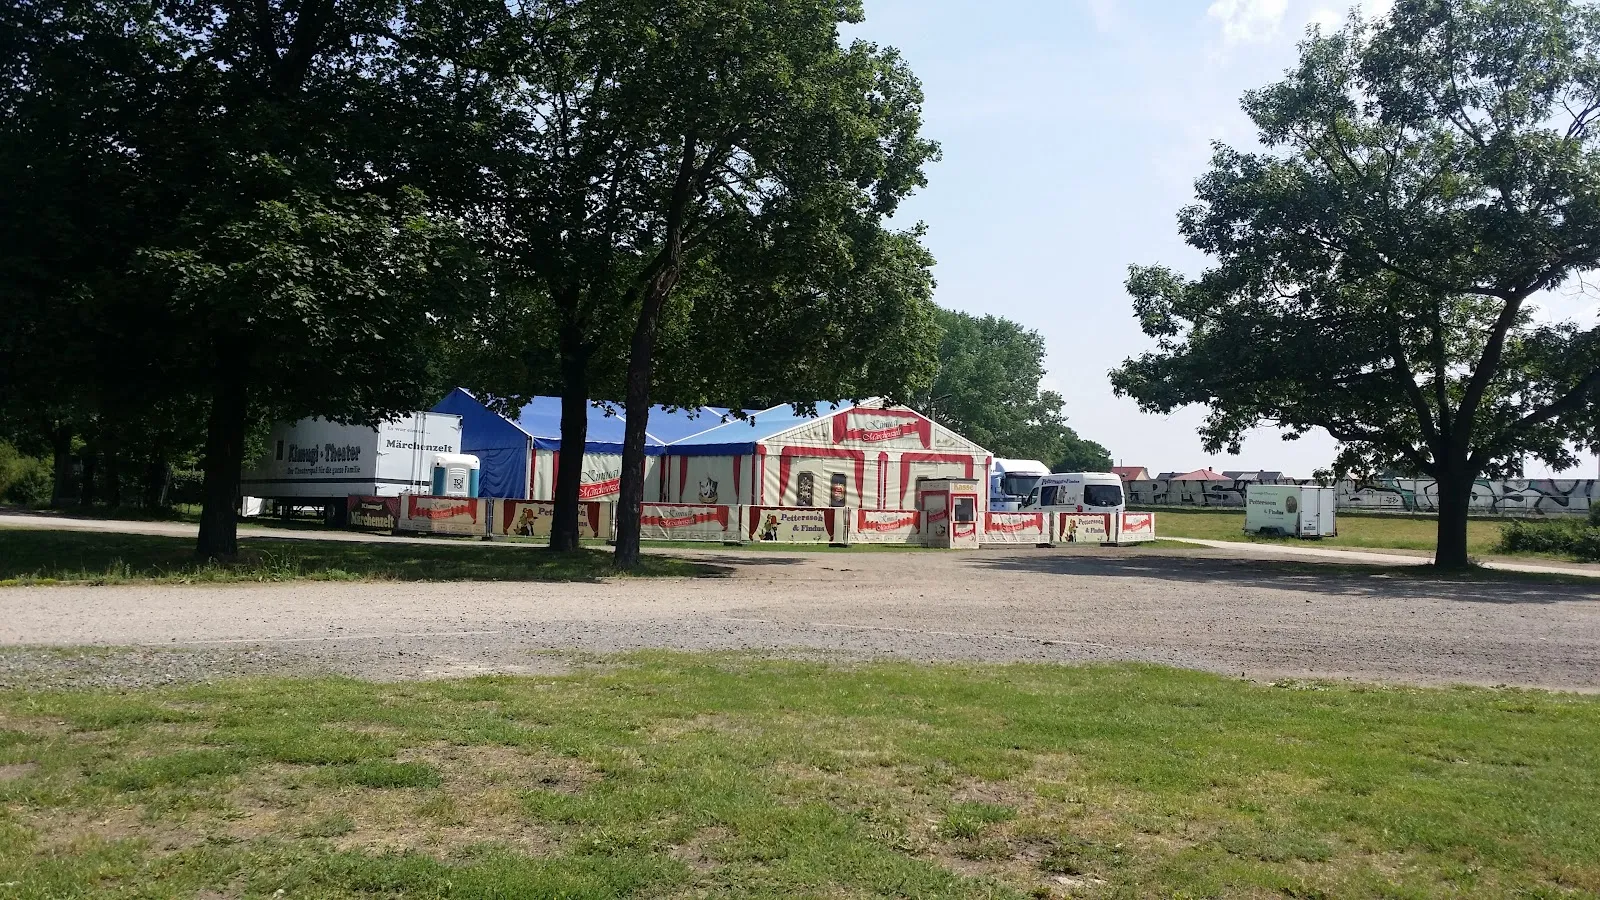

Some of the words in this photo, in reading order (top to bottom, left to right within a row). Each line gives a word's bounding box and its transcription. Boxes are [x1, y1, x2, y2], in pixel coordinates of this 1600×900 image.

[386, 440, 453, 453] Märchenzelt
[288, 444, 319, 466] Kimugi
[325, 443, 361, 462] Theater
[344, 465, 361, 473] Familie
[954, 482, 974, 491] Kasse
[351, 511, 395, 529] Märchenzelt
[780, 513, 823, 522] Pettersson
